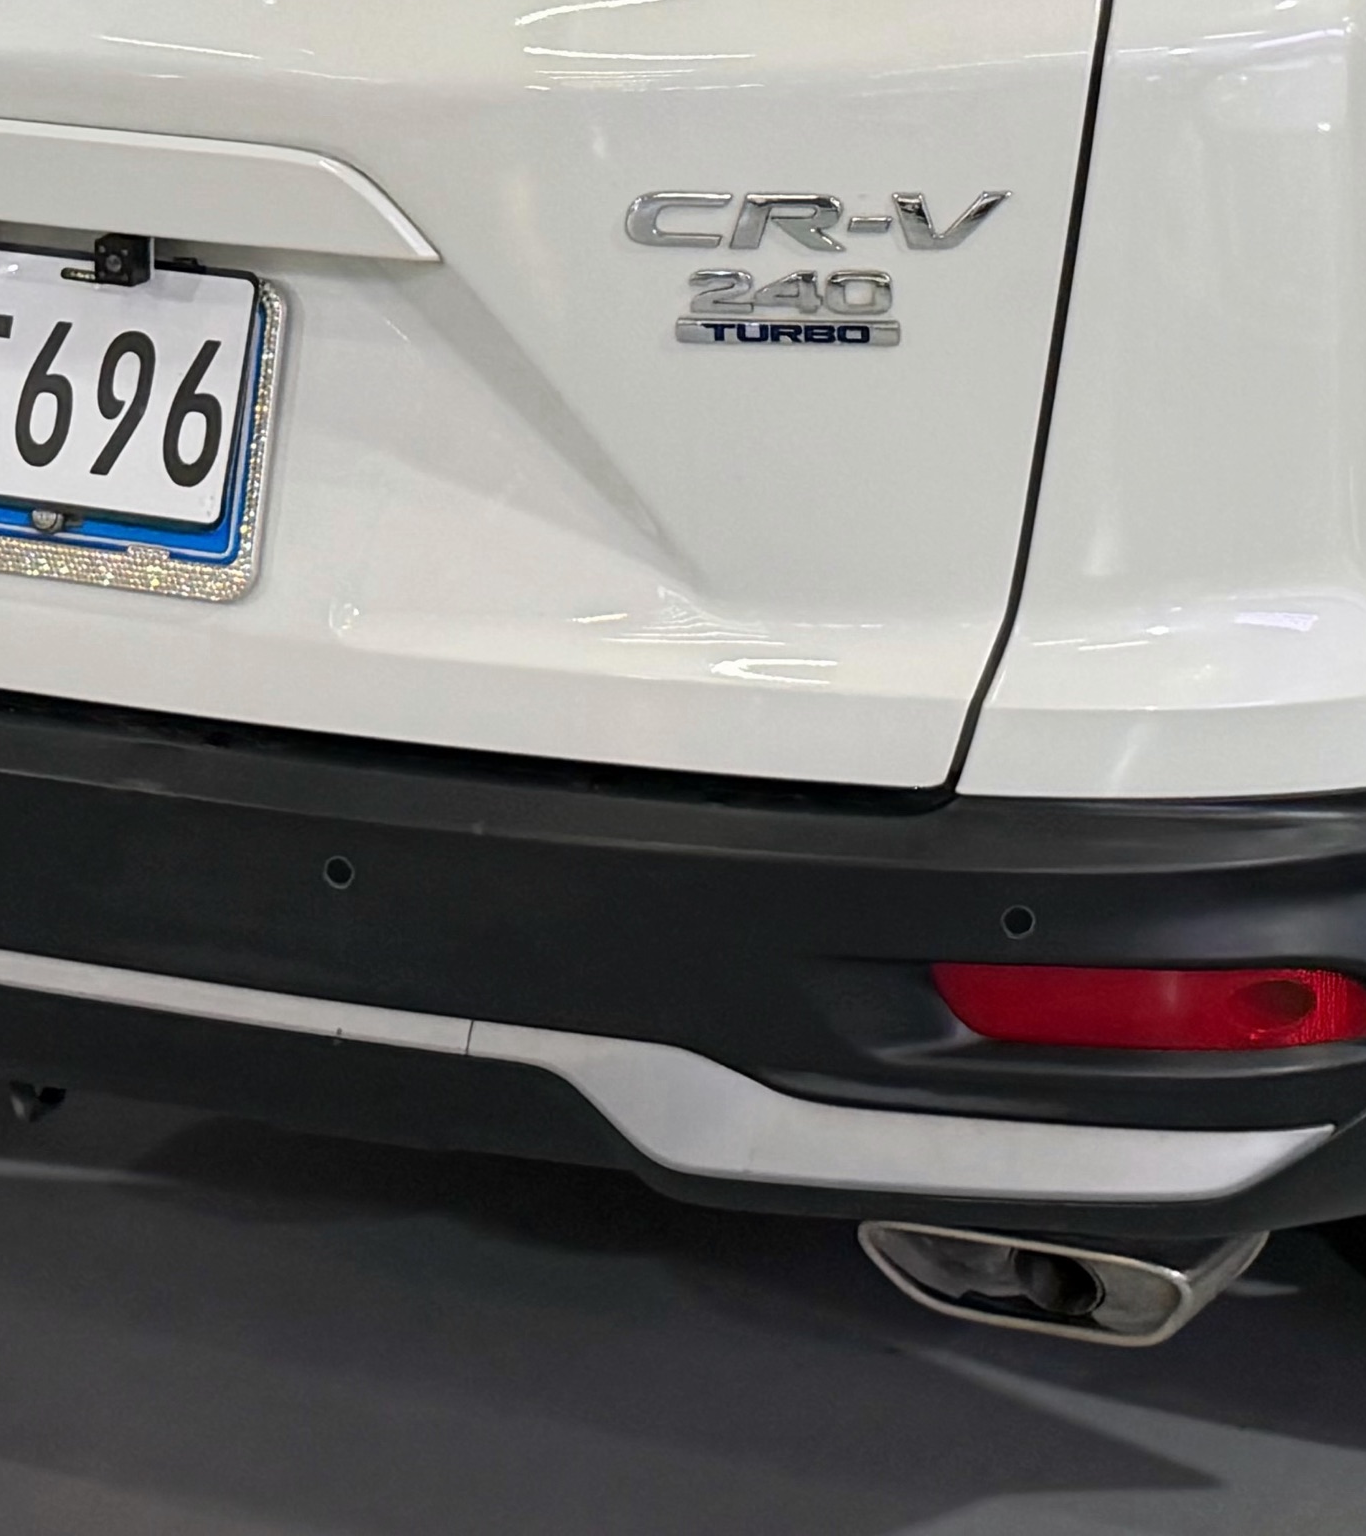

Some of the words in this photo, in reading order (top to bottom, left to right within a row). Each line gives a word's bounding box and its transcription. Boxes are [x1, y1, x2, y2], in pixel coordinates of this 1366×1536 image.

[623, 189, 1014, 253] CR-V
[688, 268, 894, 315] 240
[702, 322, 872, 345] TURBO
